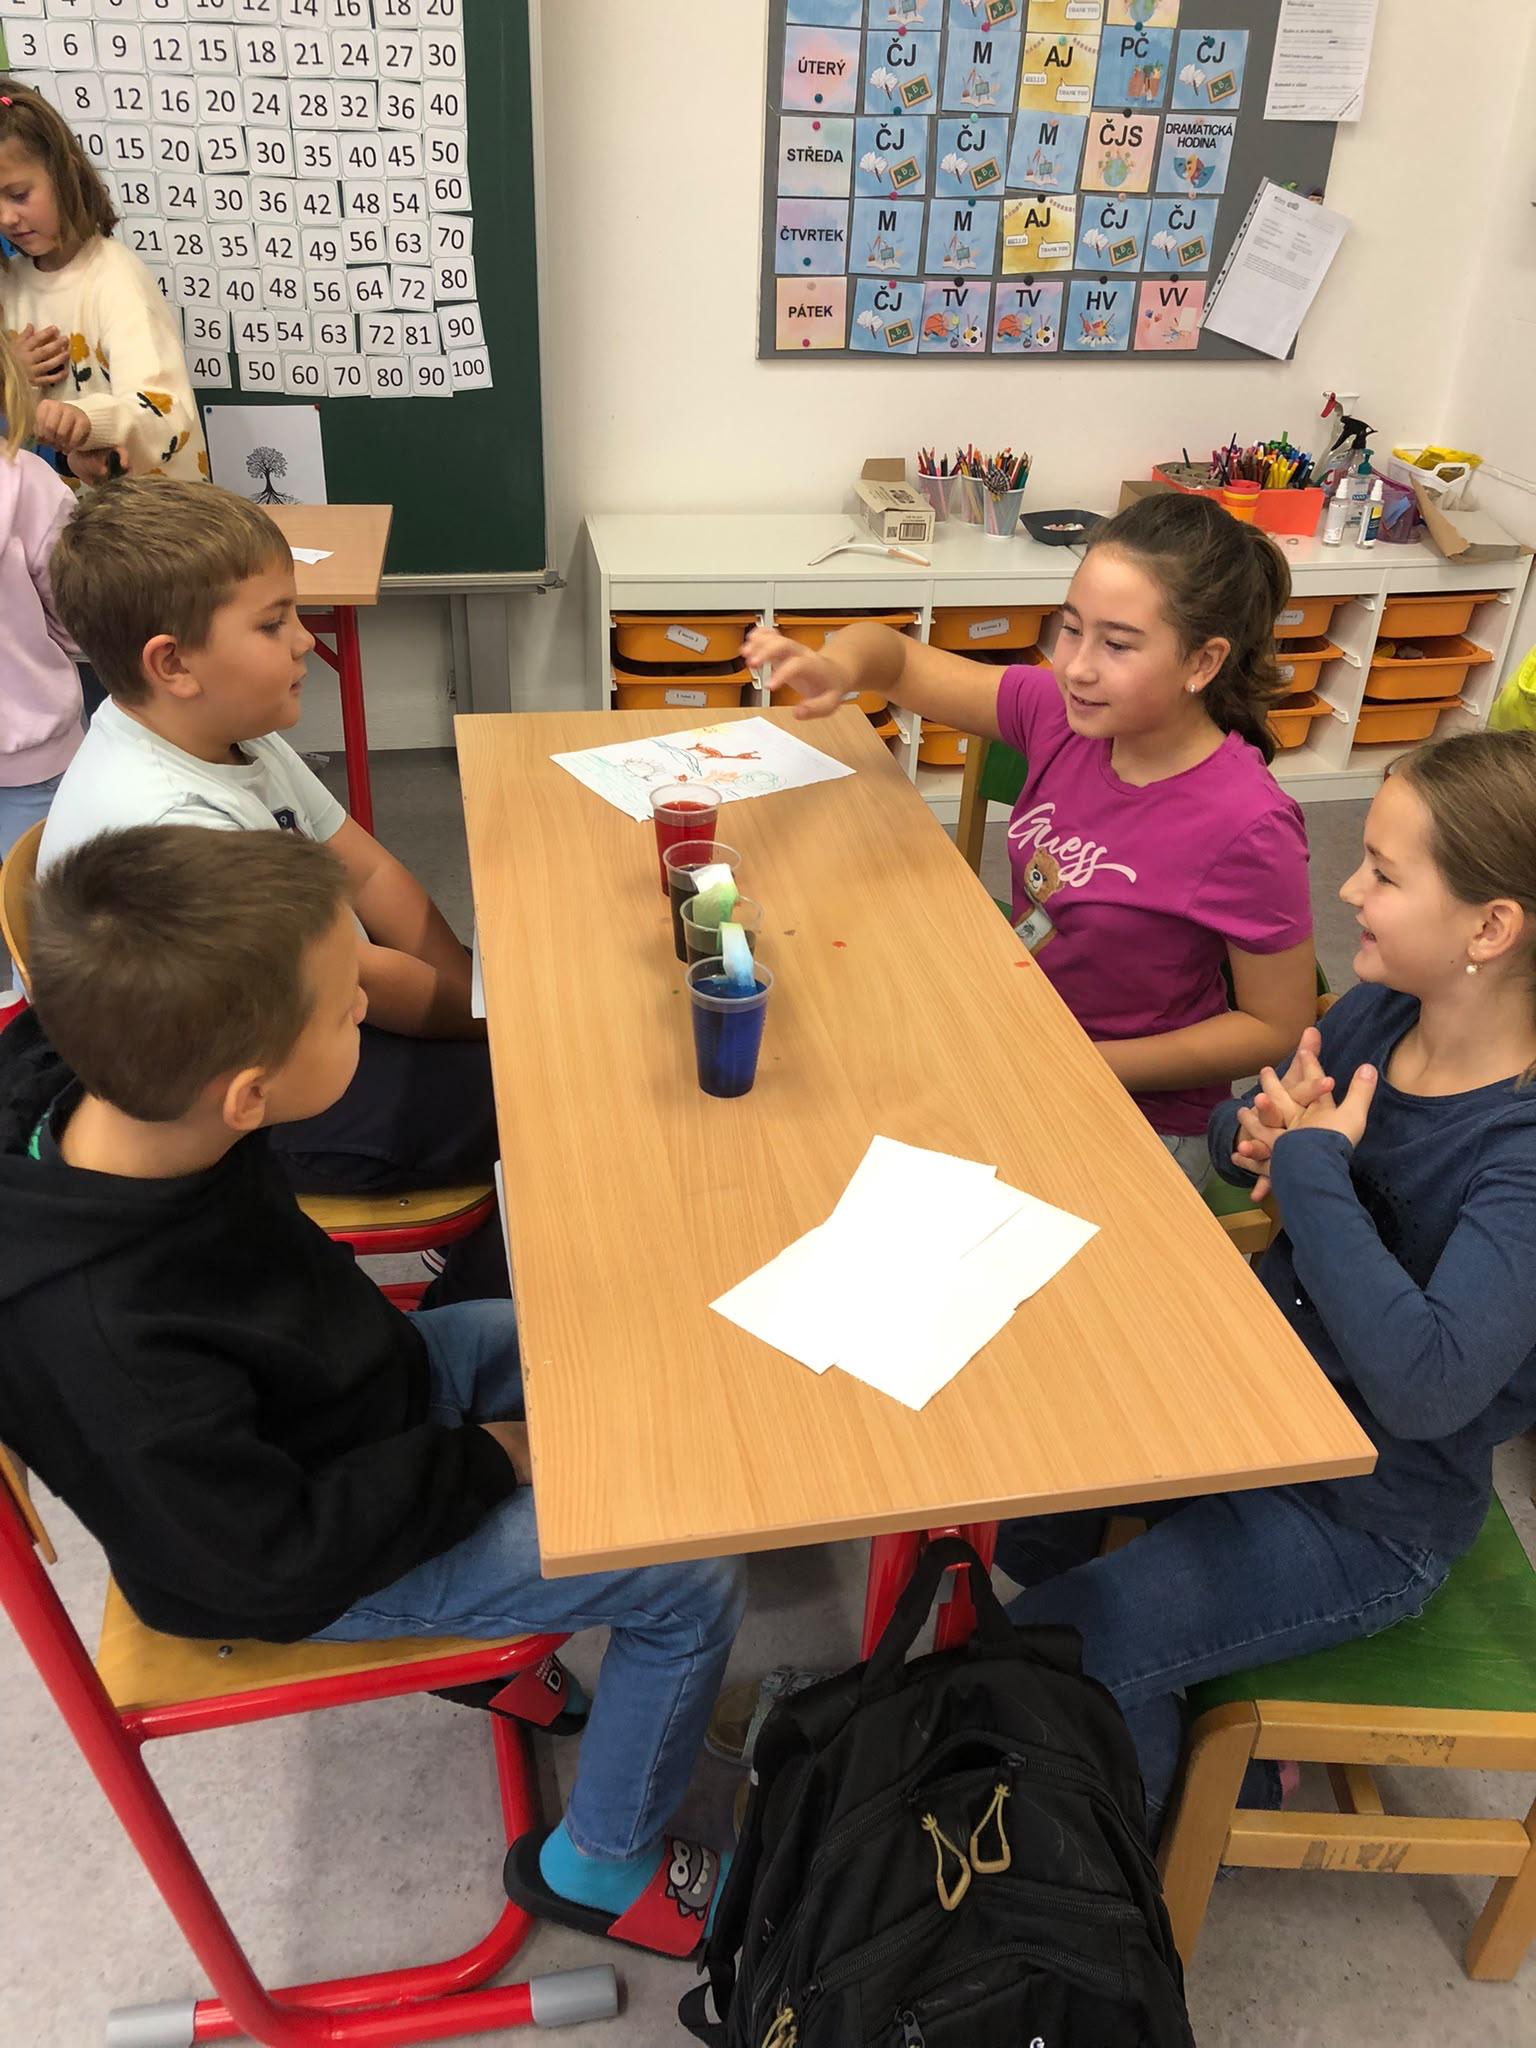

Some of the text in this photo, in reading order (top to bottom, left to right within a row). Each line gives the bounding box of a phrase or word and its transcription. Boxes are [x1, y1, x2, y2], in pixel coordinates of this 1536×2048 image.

[22, 33, 456, 68] 3 6 9 12 15 18 21 24 27 30
[886, 37, 917, 67] ČJ
[972, 41, 993, 64] M
[1044, 45, 1074, 68] AJ
[1120, 32, 1149, 58] PČ
[1196, 35, 1225, 63] ČJ
[798, 56, 846, 76] ÚTERÝ
[74, 86, 458, 120] 8 12 16 20 24 28 32 36 40
[875, 123, 905, 151] ČJ
[956, 125, 986, 151] ČJ
[1038, 123, 1059, 146] M
[1099, 118, 1144, 148] ČJS
[1165, 123, 1233, 136] DRAMATICKÁ
[115, 137, 145, 160] 15
[160, 138, 190, 162] 20
[207, 137, 237, 161] 25
[256, 141, 285, 164] 30
[303, 145, 332, 168] 35
[348, 146, 377, 168] 40
[388, 145, 415, 167] 45
[431, 140, 459, 164] 50
[786, 146, 843, 163] STŘEDA
[1177, 137, 1217, 149] HODINA
[121, 182, 150, 205] 18
[168, 185, 197, 208] 24
[214, 189, 243, 211] 30
[259, 190, 287, 213] 36
[303, 193, 332, 215] 42
[352, 192, 380, 214] 48
[393, 192, 420, 214] 54
[435, 178, 462, 200] 60
[878, 210, 897, 232] M
[954, 211, 973, 231] M
[1024, 207, 1050, 229] AJ
[1100, 203, 1128, 229] ČJ
[1168, 204, 1196, 230] ČJ
[132, 226, 464, 262] 21 28 35 42 49 56 63 70
[780, 225, 844, 242] ČTVRTEK
[157, 268, 468, 302] 4 32 40 48 56 64 72 80
[942, 288, 969, 307] TV
[1159, 287, 1189, 307] VV
[788, 303, 833, 319] PÁTEK
[874, 285, 903, 312] ČJ
[1016, 289, 1042, 308] TV
[1086, 290, 1118, 311] HV
[194, 316, 475, 346] 36 45 54 63 72 81 90
[193, 357, 485, 387] 40 50 60 70 80 90 100
[1008, 802, 1137, 887] Guess
